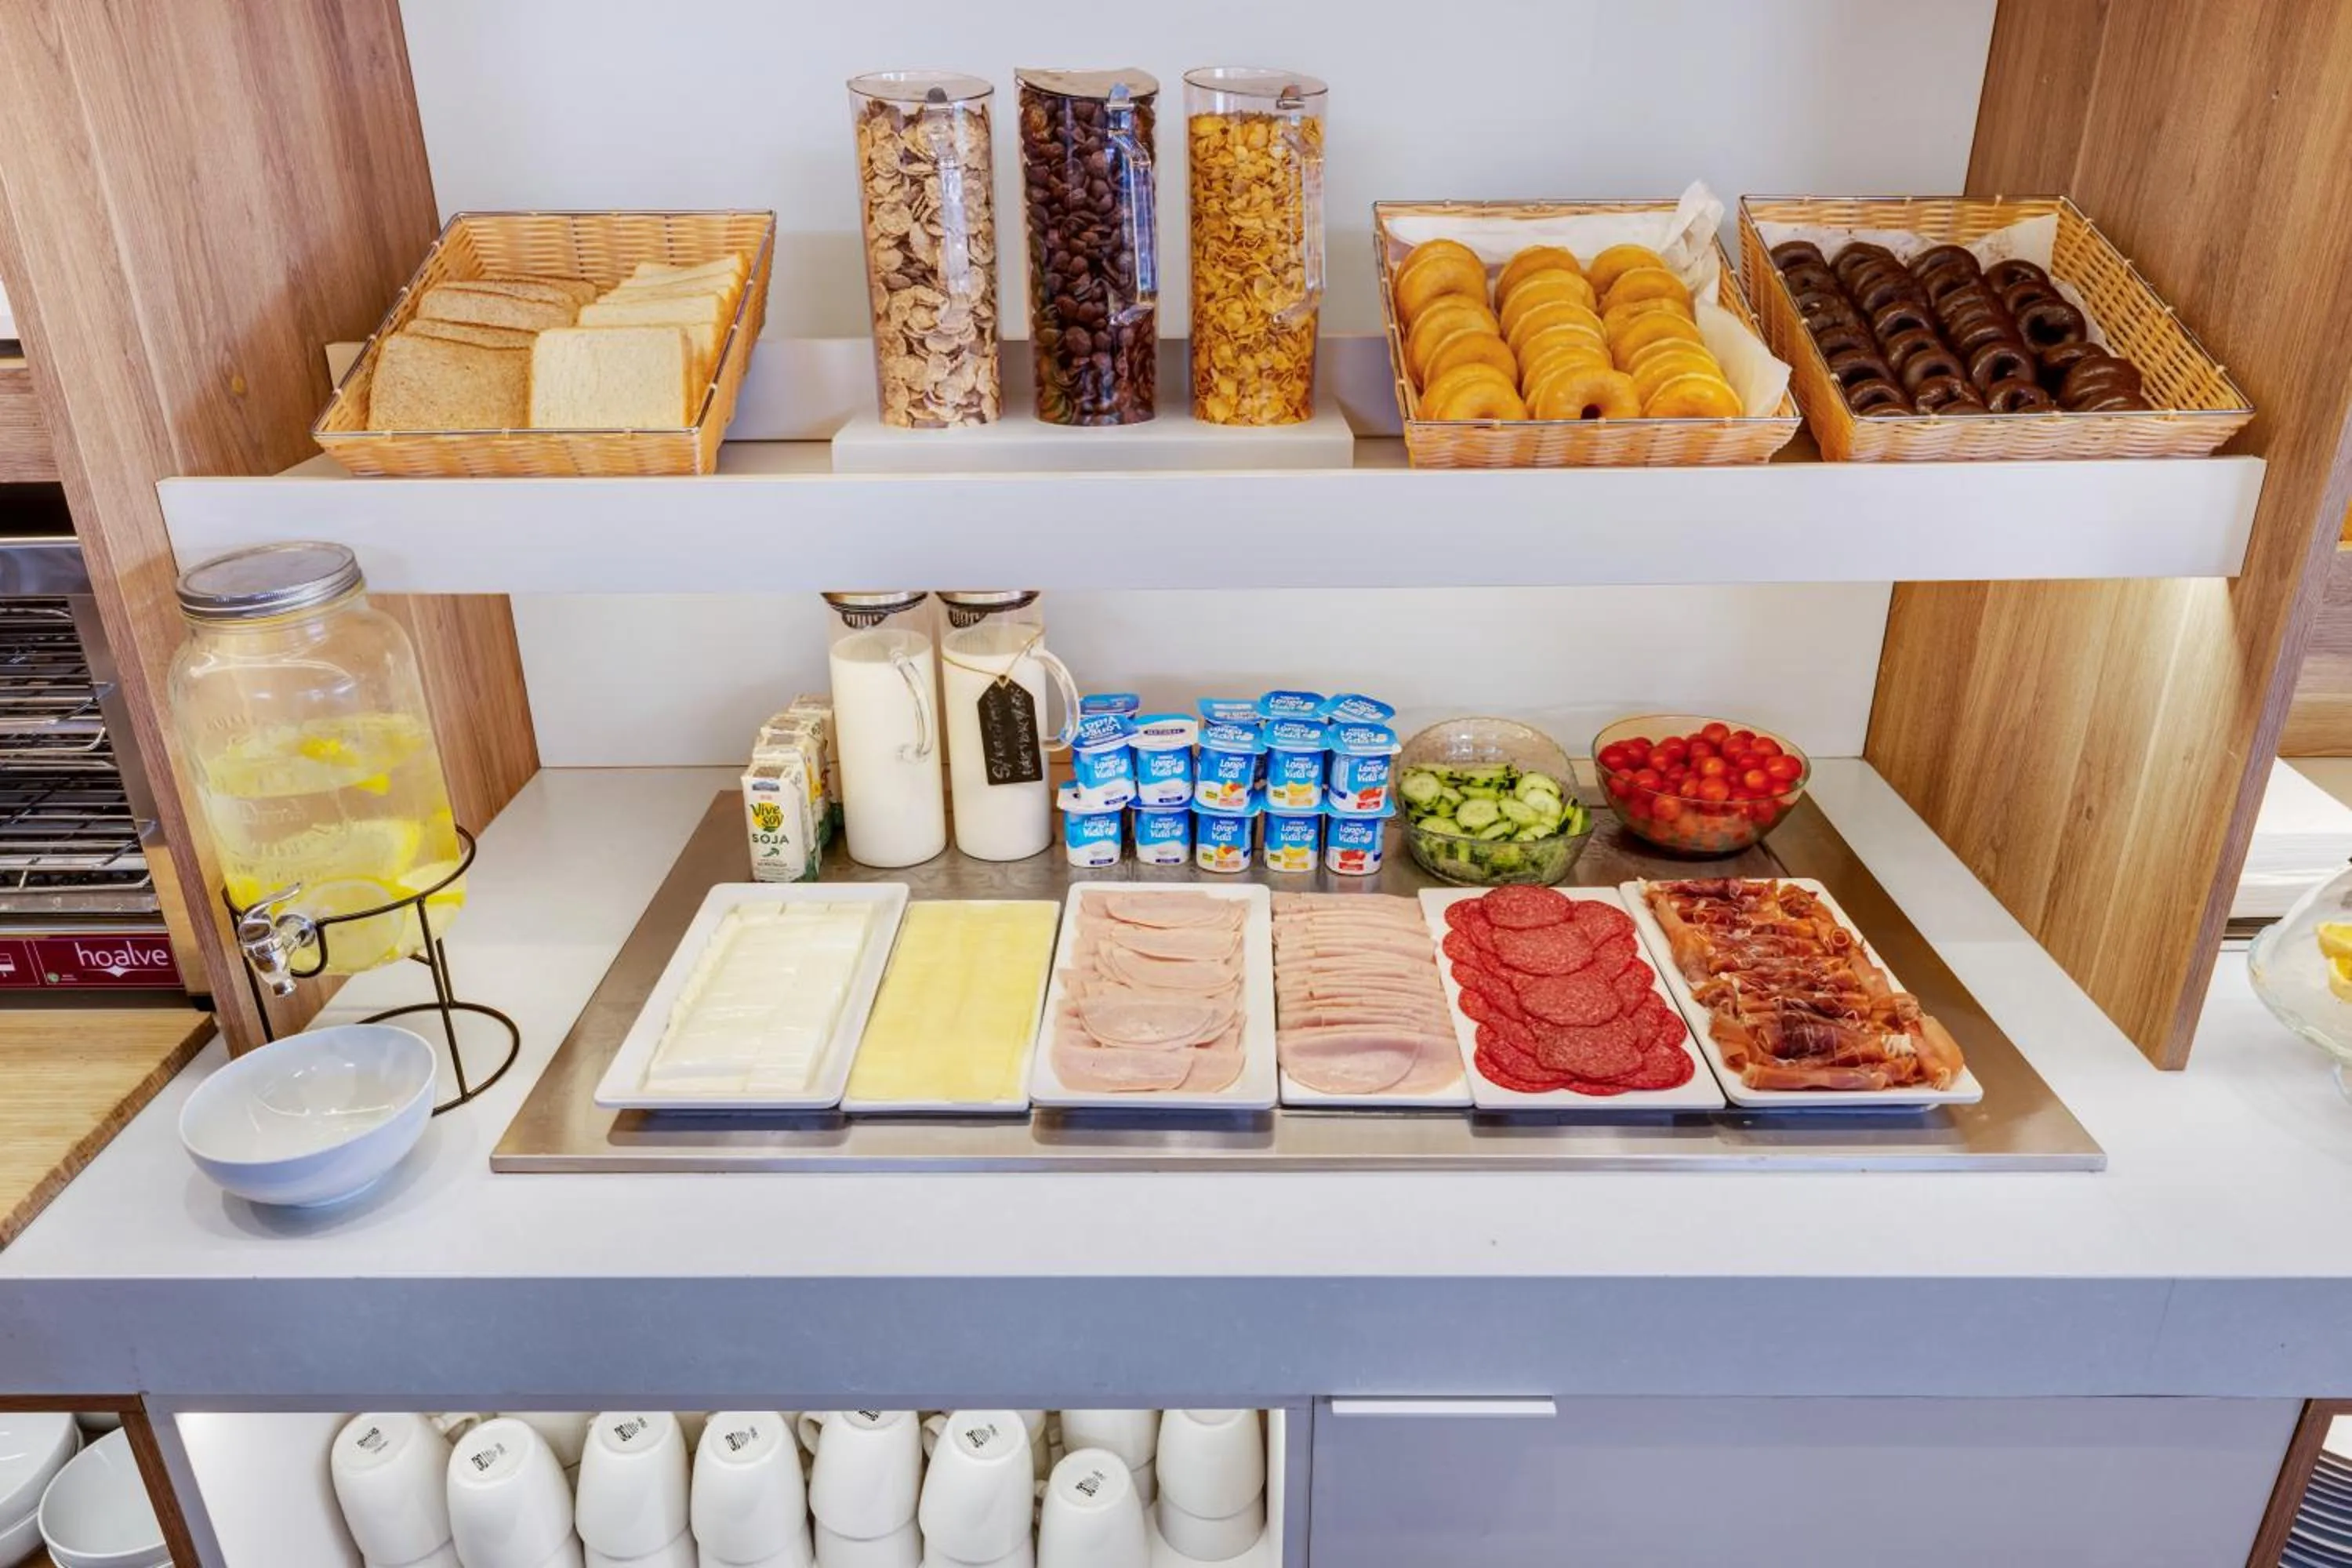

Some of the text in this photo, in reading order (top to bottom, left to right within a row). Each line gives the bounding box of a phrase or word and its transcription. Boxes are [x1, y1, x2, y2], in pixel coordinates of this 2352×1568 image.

[750, 802, 781, 817] Vive
[752, 833, 789, 844] SOJA
[74, 940, 169, 967] hoalve
